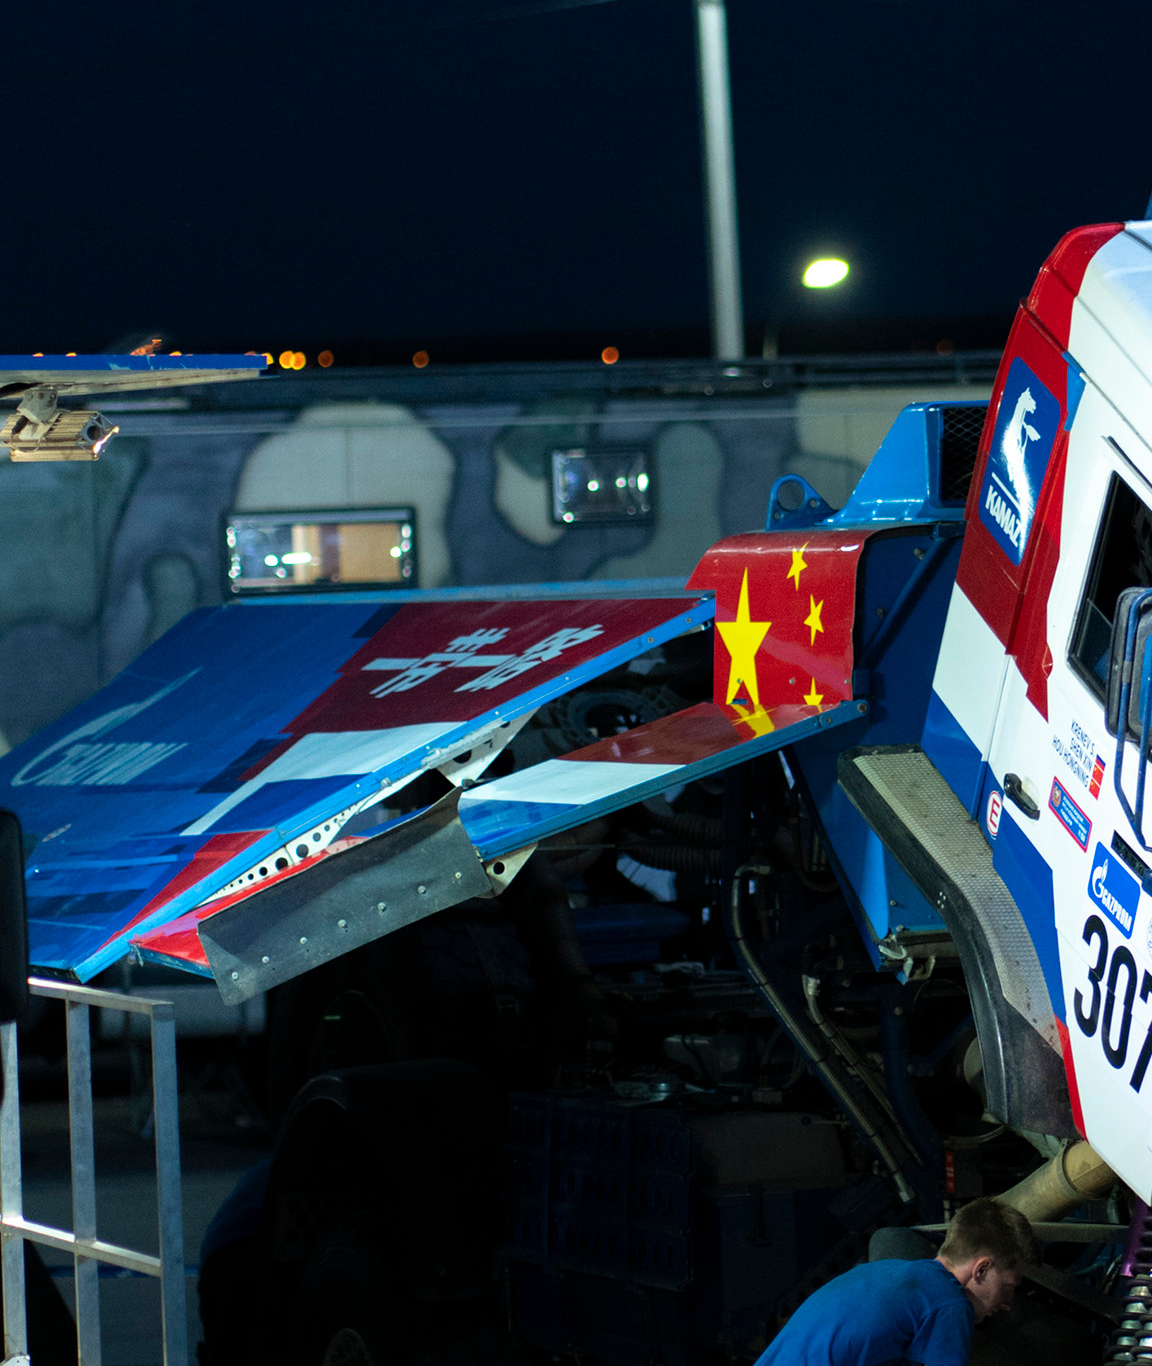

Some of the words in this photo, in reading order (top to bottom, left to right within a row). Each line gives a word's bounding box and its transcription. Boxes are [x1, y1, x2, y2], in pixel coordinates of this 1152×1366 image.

[985, 484, 1023, 548] KAMAZ
[360, 623, 605, 699] 一带一路
[1101, 886, 1133, 932] GAZPROM
